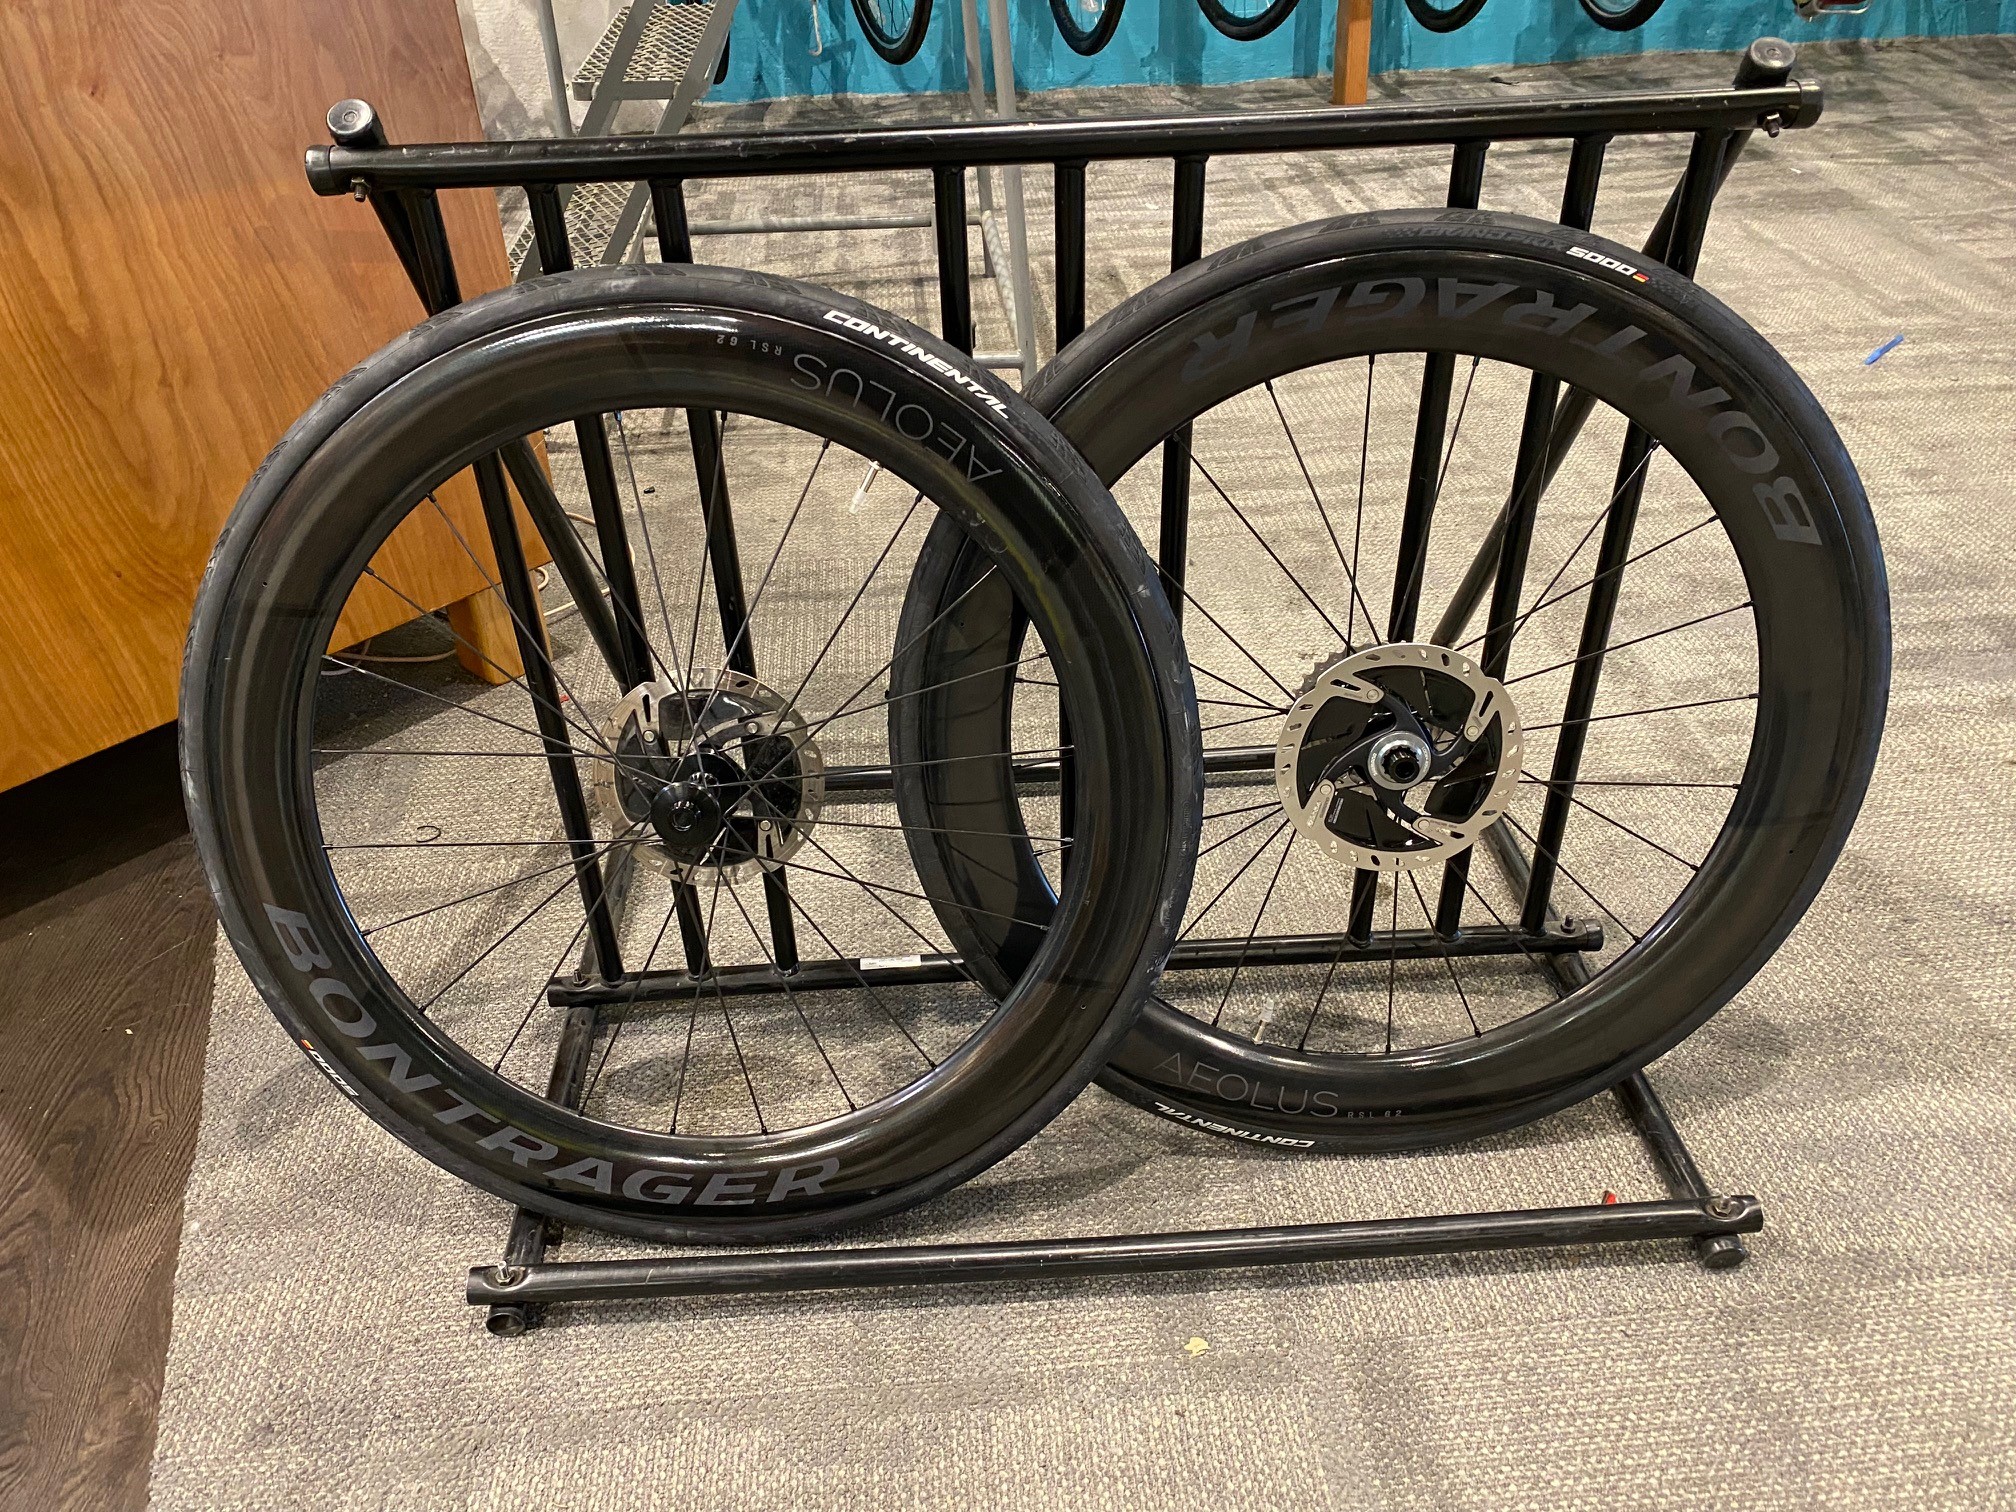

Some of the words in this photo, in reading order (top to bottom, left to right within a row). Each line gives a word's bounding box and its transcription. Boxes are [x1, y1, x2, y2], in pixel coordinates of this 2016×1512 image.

[1565, 245, 1638, 276] 5000
[716, 334, 738, 347] 62
[750, 339, 783, 356] RSL
[822, 309, 1011, 420] CONTINENTAL
[789, 352, 1004, 483] AEOLUS
[1181, 276, 1823, 546] BONTRAGER
[263, 902, 841, 1207] BONTRAGER
[308, 1048, 360, 1097] 5000
[1153, 1052, 1339, 1118] AEOLUS
[1347, 1111, 1375, 1119] RSL
[1384, 1109, 1402, 1118] 62
[1154, 1102, 1317, 1148] CONTINENTAL
